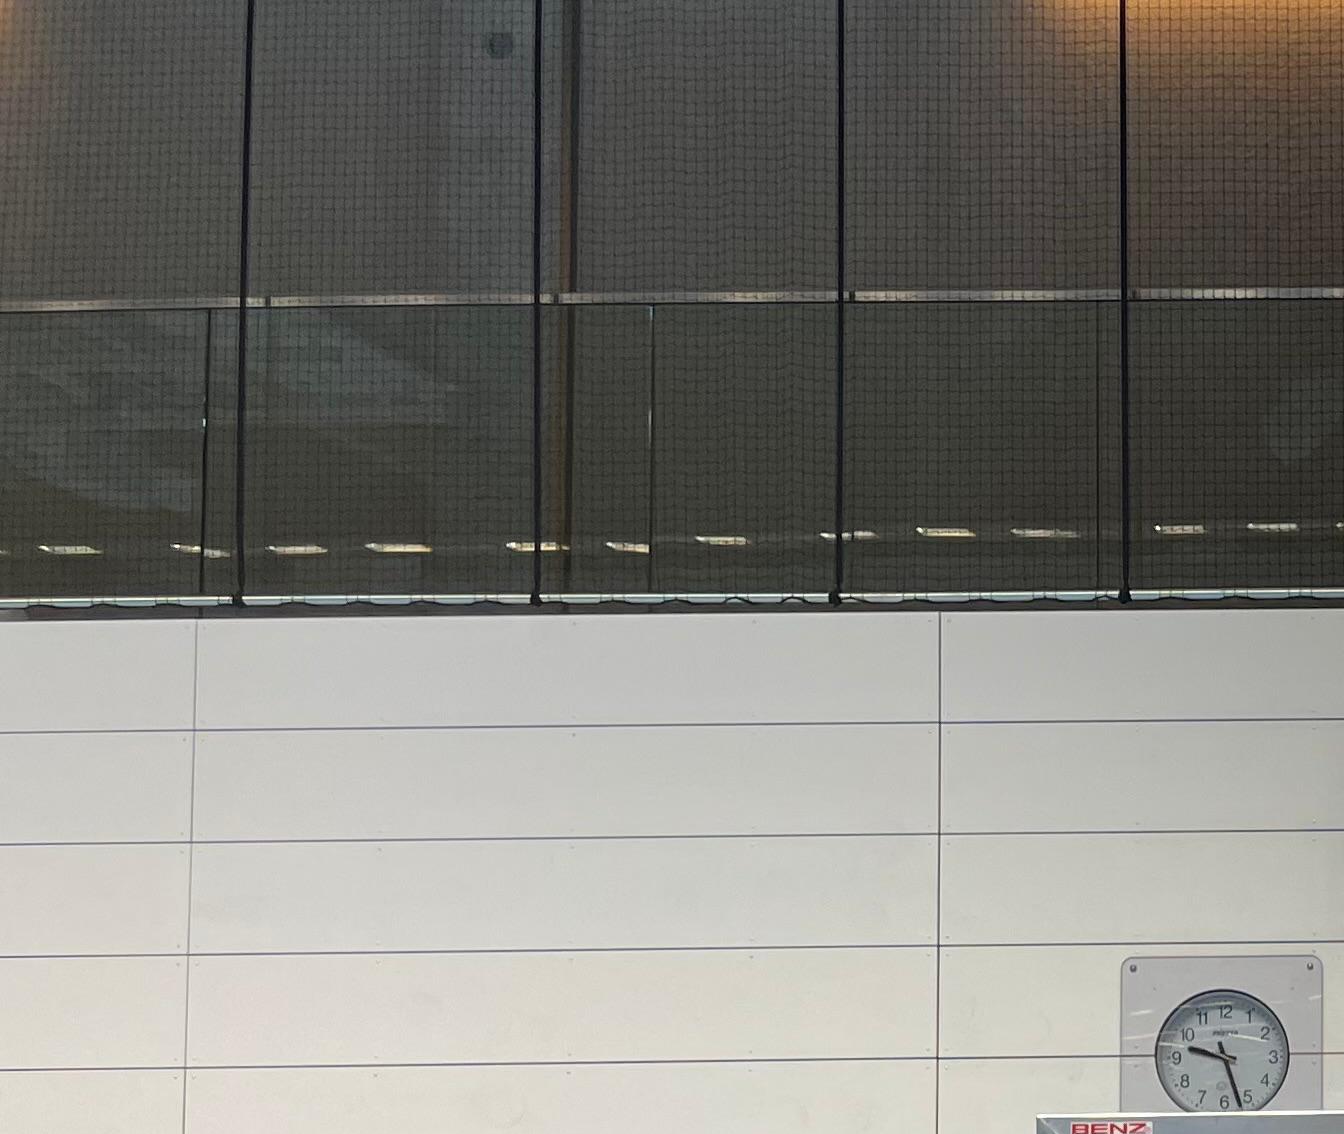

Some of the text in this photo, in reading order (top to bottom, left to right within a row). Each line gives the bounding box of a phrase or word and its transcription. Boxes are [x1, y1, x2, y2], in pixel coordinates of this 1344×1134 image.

[1198, 1011, 1209, 1025] 11
[1219, 1004, 1233, 1019] 12
[1181, 1027, 1195, 1042] 10
[1260, 1026, 1271, 1041] 2
[1171, 1050, 1182, 1065] 9
[1268, 1050, 1279, 1064] 3
[1180, 1074, 1190, 1088] 8
[1259, 1073, 1269, 1087] 4
[1198, 1090, 1208, 1105] 7
[1219, 1095, 1230, 1110] 6
[1243, 1090, 1253, 1104] 5
